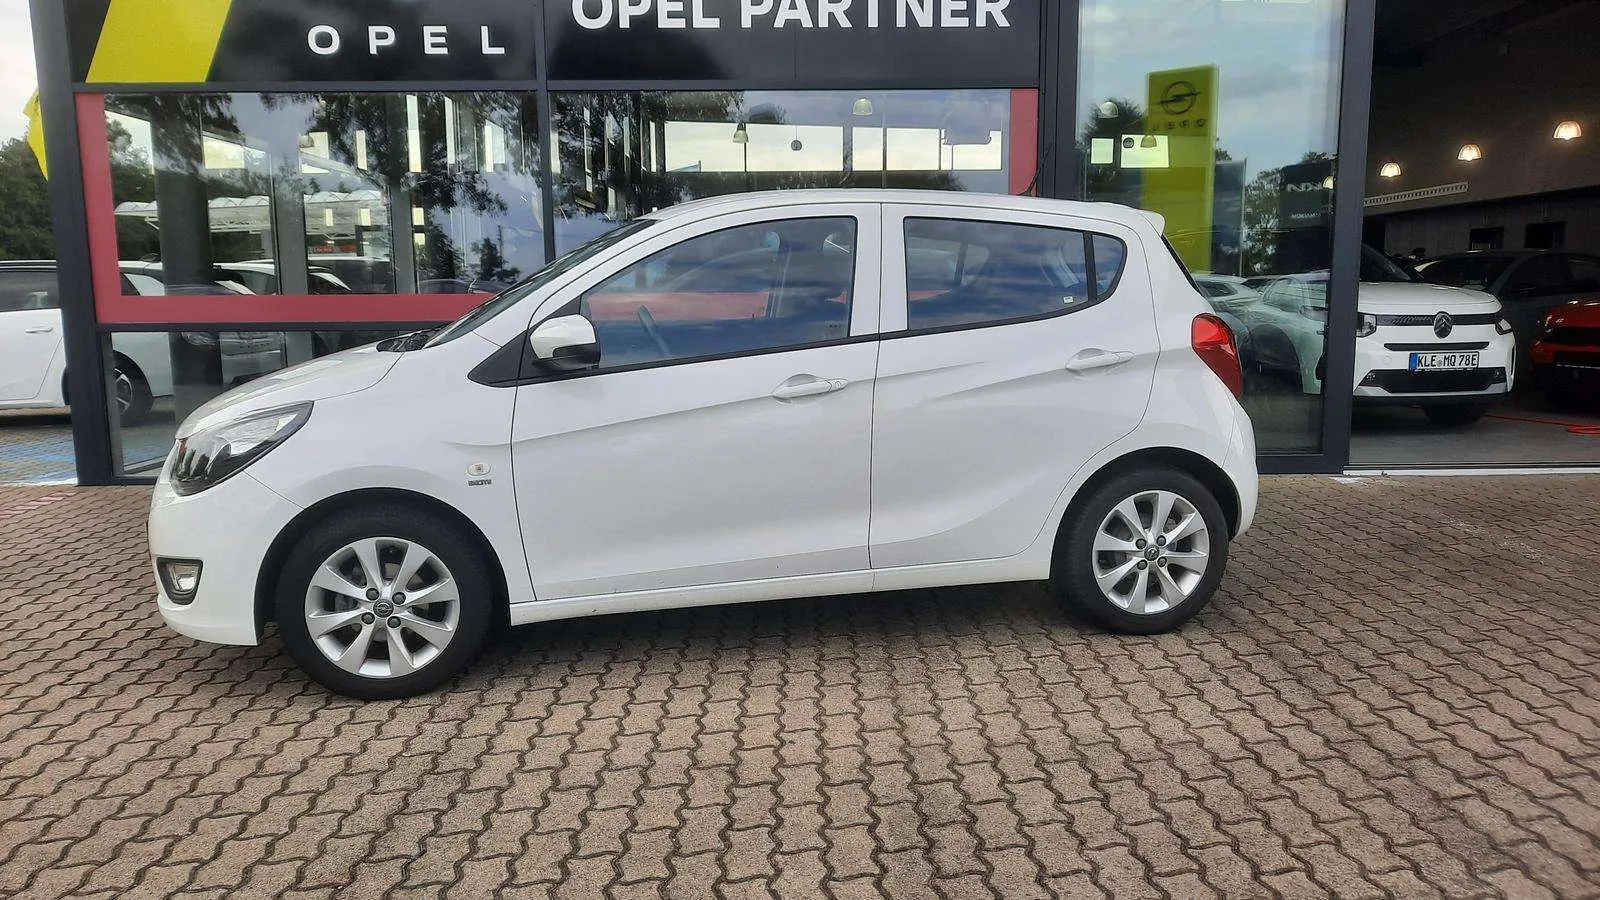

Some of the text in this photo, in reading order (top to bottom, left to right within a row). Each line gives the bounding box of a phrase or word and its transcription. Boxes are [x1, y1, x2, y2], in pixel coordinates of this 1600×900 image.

[571, 0, 720, 29] OPEL
[307, 25, 505, 54] OPEL
[1417, 354, 1478, 367] KLE MQ 78E
